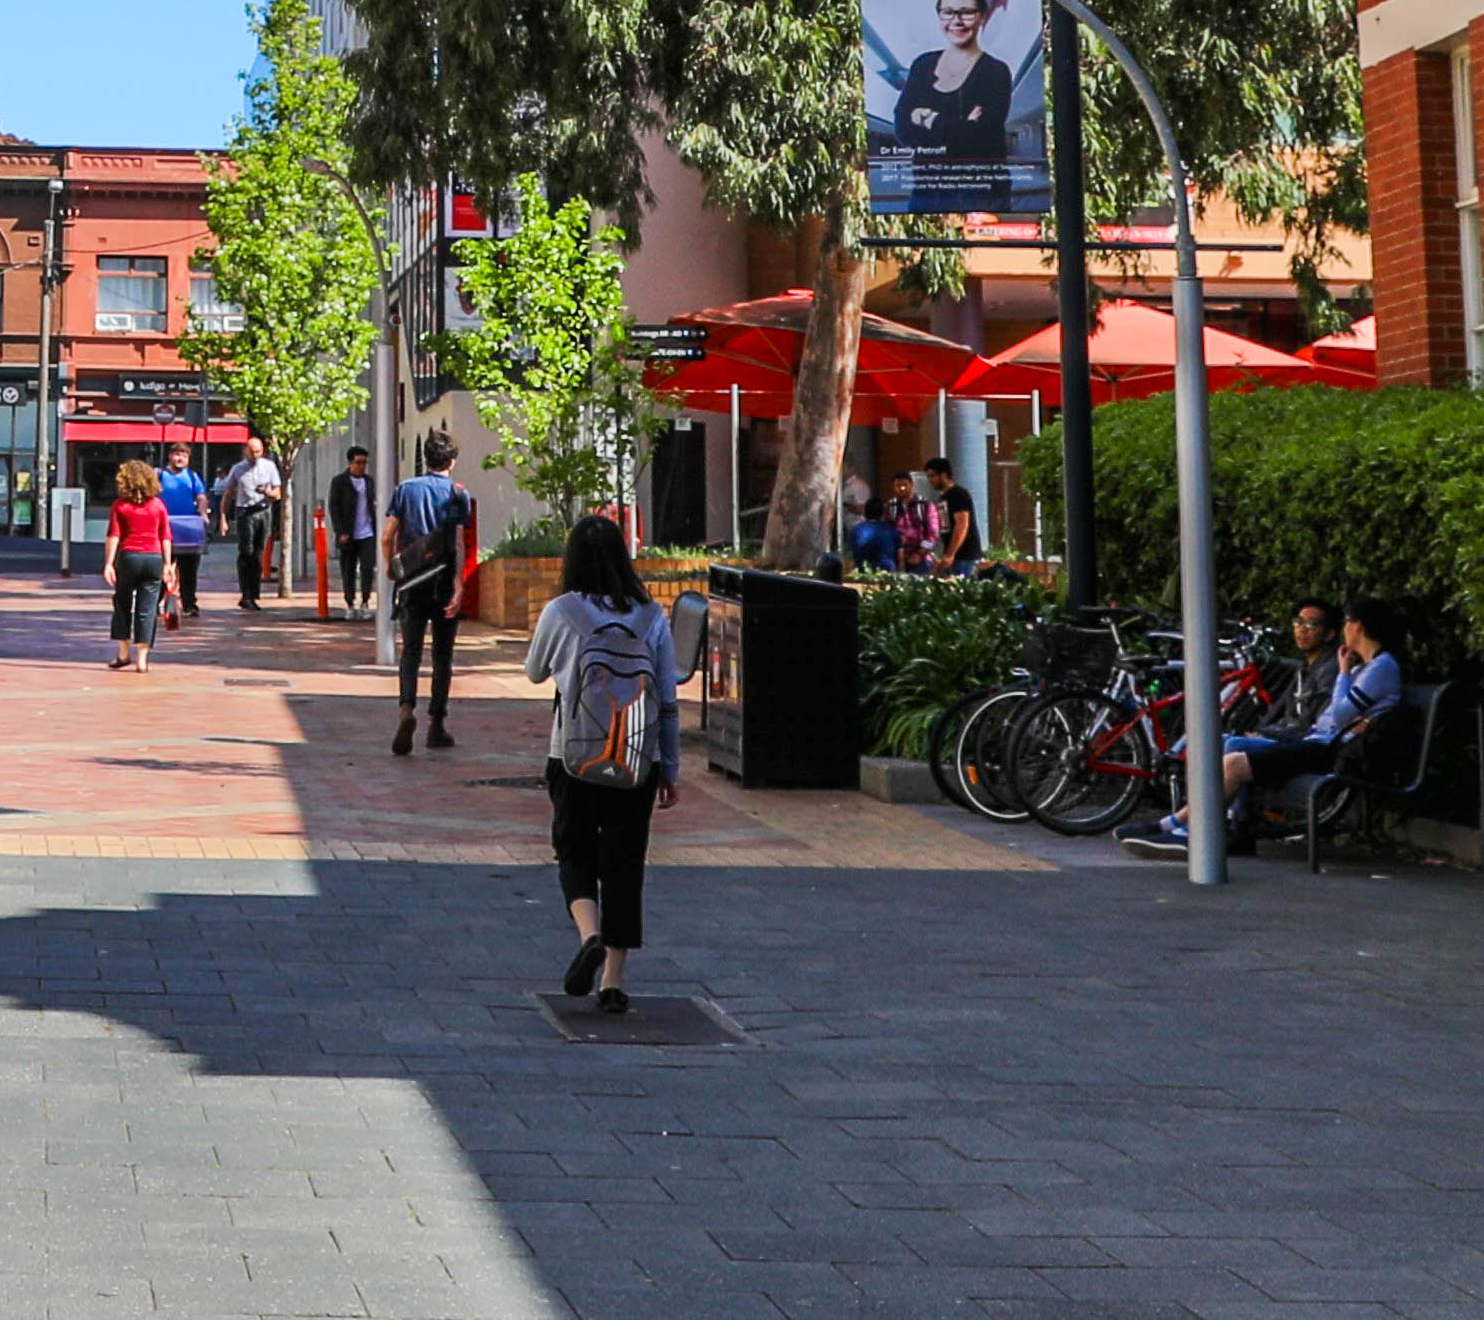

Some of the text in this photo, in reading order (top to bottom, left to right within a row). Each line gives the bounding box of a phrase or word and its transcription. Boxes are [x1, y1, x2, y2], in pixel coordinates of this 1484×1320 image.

[880, 146, 947, 158] Dr Emily Petroff
